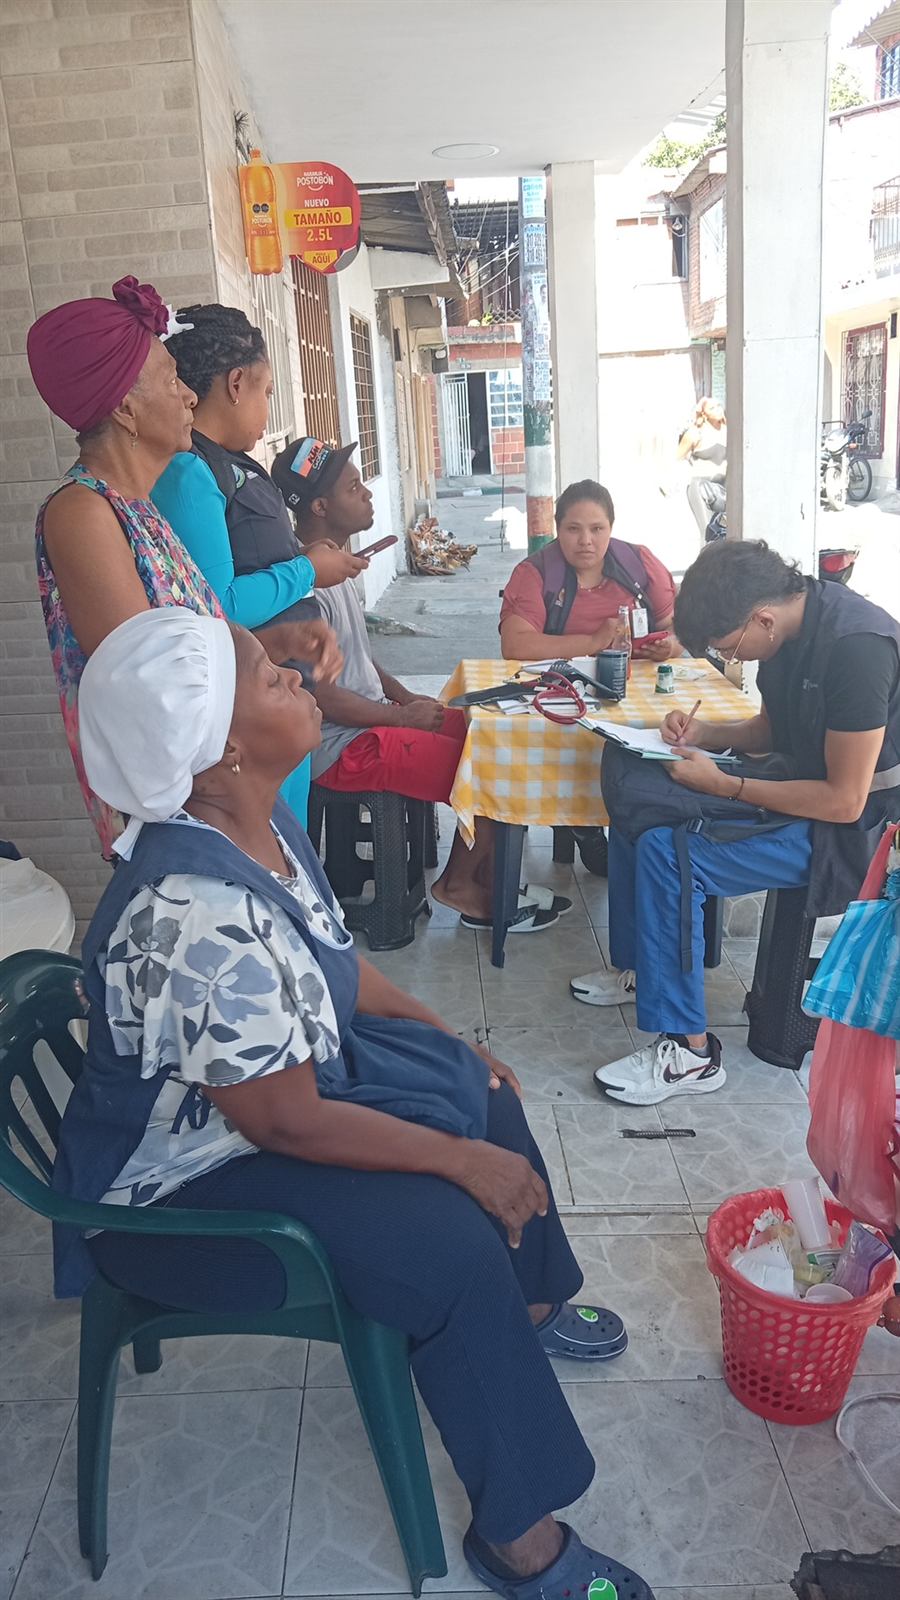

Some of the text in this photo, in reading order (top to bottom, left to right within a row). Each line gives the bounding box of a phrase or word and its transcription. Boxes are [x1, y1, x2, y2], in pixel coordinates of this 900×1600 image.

[304, 198, 330, 207] NUEVO
[293, 210, 342, 225] TAMAÑO
[306, 228, 333, 241] 2.5L
